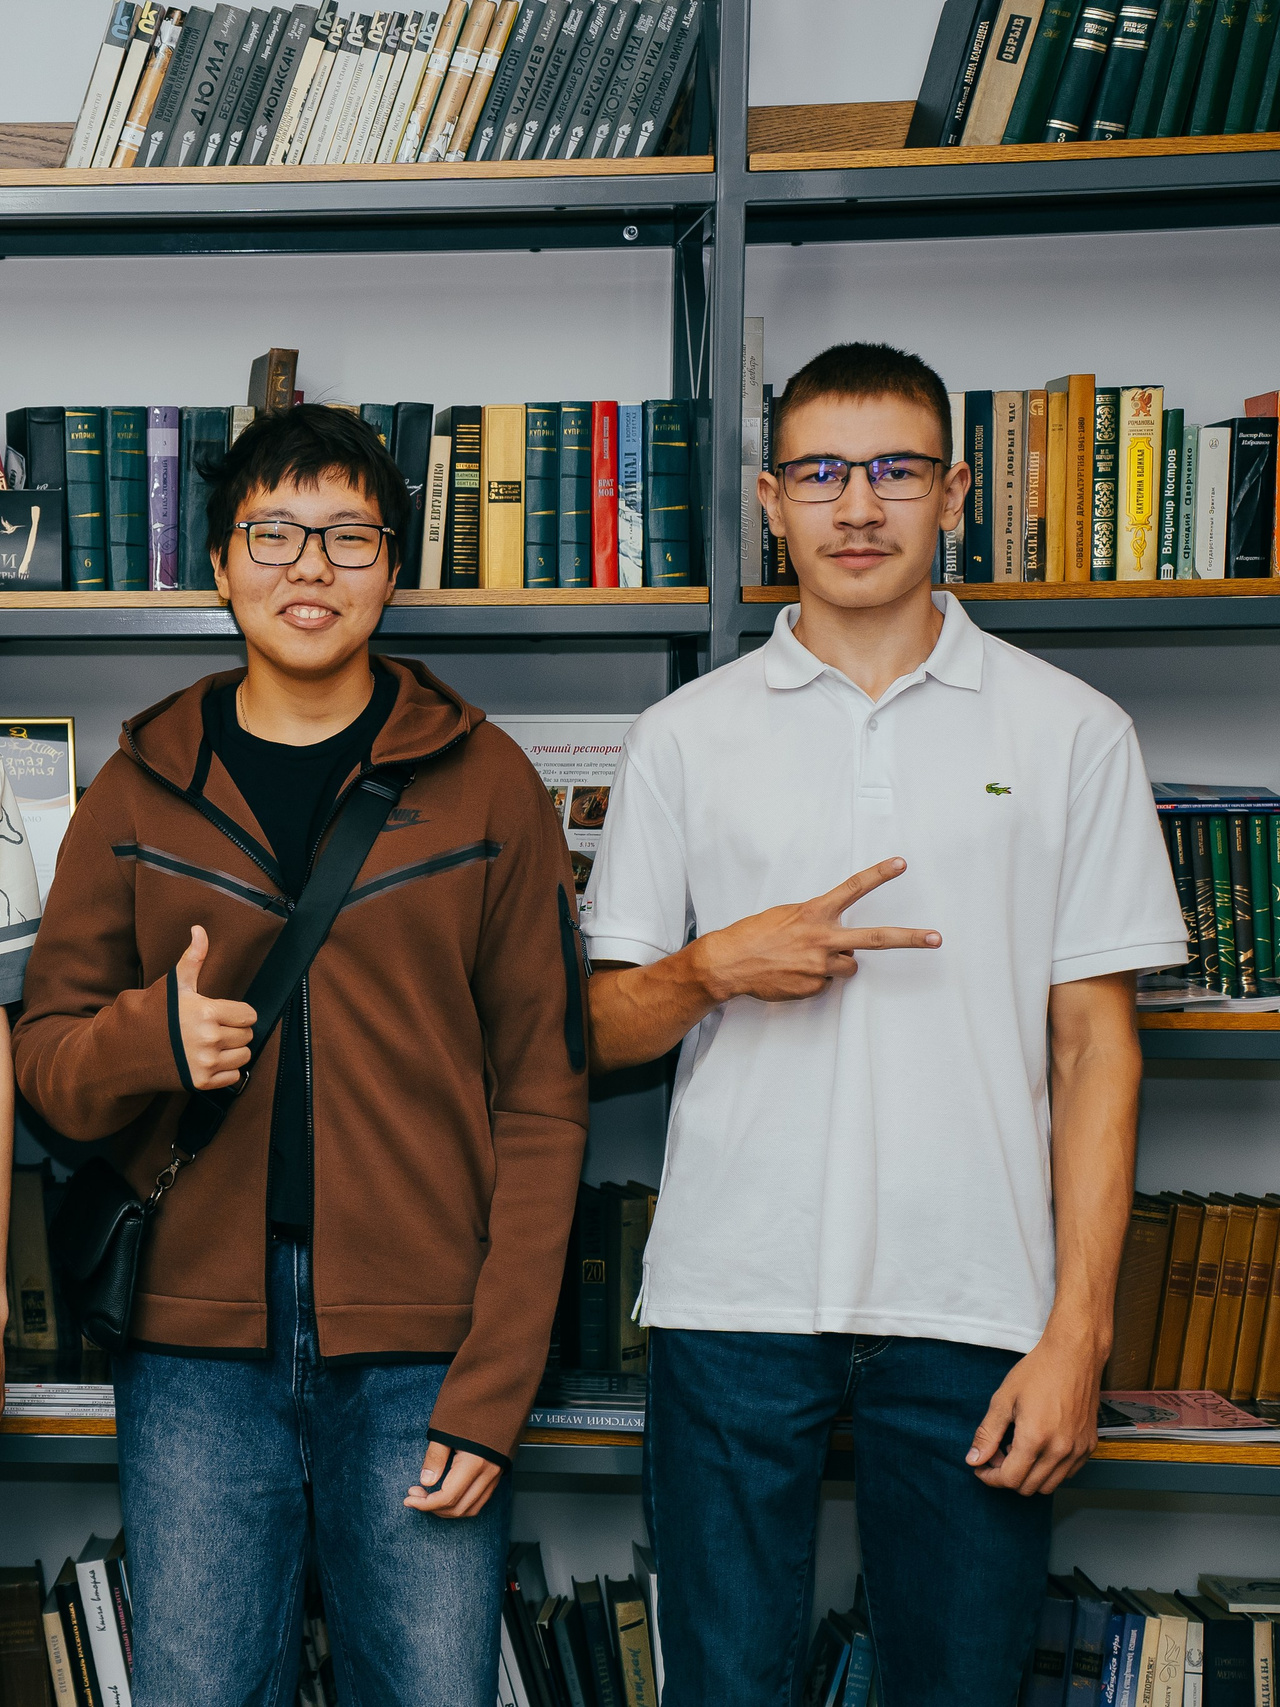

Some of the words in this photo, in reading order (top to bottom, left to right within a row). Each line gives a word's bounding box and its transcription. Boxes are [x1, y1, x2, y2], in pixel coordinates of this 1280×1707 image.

[969, 20, 990, 62] КАРЕНИНА
[1001, 17, 1025, 60] ОБРЫВ
[162, 89, 180, 122] ВЕЛИКОЙ
[173, 28, 200, 89] ОТЕЧЕСТВЕННОЙ
[190, 39, 228, 126] ДЮМА
[262, 45, 296, 123] МОПАССАН
[324, 80, 342, 122] ПОШЕХОНСКАЯ
[337, 54, 350, 80] СТАРИНА
[486, 48, 521, 123] ВАШИНГТОН
[510, 44, 545, 115] ЧААДАЕВ
[534, 47, 567, 111] ПУАНКАРЕ
[555, 75, 577, 122] АЛЕКСАНДР
[572, 38, 596, 76] БЛОК
[580, 47, 614, 117] БРУСИЛОВ
[601, 75, 629, 123] ЖОРЖ
[620, 34, 644, 71] САНД
[627, 71, 651, 117] ДЖОН
[645, 40, 664, 67] РИД
[648, 70, 673, 119] ЛЕОНАРДО
[670, 27, 690, 61] ВИНЧИ
[963, 62, 978, 84] АННА
[218, 66, 244, 120] БЕХТЕРЕВ
[236, 63, 266, 125] ПАГАНИНИ
[334, 96, 353, 141] ОЧАРОВАННЫЙ
[349, 62, 365, 96] СТРАННИК
[86, 92, 102, 131] ДРЕВНОСТЕЙ
[108, 100, 122, 130] ТРАГЕДИИ
[391, 101, 406, 132] РАССКАЗЫ
[296, 116, 309, 145] ДЕРЕВНЯ
[356, 116, 370, 146] НАКАНУНЕ
[1057, 132, 1066, 143] 3
[1008, 402, 1016, 423] ЧАС
[529, 429, 555, 437] КУПРИН
[975, 425, 984, 450] ПОЭЗИИ
[1077, 416, 1085, 452] 1941-1980
[974, 451, 983, 487] ИРКУТСКОЙ
[1007, 429, 1016, 476] ДОБРЫЙ
[1136, 448, 1145, 478] ВЕЛИКАЯ
[598, 479, 614, 487] БРАТ
[624, 451, 637, 507] БАЙКАЛ
[1028, 450, 1040, 508] ШУКШИН
[1076, 454, 1085, 516] ДРАМАТУРГИЯ
[1164, 448, 1177, 497] Костров
[430, 463, 444, 520] ЕВТУШЕНКО
[598, 487, 614, 497] МОЙ
[974, 488, 984, 524] АНТОЛОГИЯ
[1136, 479, 1144, 514] ЕКАТЕРИНА
[1208, 486, 1216, 515] Эрмитаж
[428, 522, 440, 542] ЕВГ.
[1005, 505, 1014, 534] Розов
[1162, 500, 1174, 555] Владимир
[666, 553, 672, 562] 4
[1005, 538, 1014, 575] Виктор
[1027, 513, 1038, 569] ВАСИЛИЙ
[1076, 519, 1084, 568] СОВЕТСКАЯ
[1206, 517, 1215, 572] Государственный
[84, 558, 92, 568] 6
[538, 557, 545, 567] 3
[574, 557, 581, 567] 2
[529, 743, 571, 755] лучший
[9, 766, 55, 780] армия
[585, 1263, 601, 1281] 20
[547, 1414, 583, 1424] МУЗЕЙ
[89, 1569, 102, 1602] вторая
[68, 1602, 77, 1625] ЯЗЫКА
[96, 1606, 106, 1632] Книга
[113, 1586, 127, 1633] УНИВЕРСИТЕТ
[50, 1634, 62, 1664] ЩИПАЧЕВ
[73, 1625, 84, 1658] РУССКОГО
[57, 1668, 67, 1694] СТЕПАН
[79, 1658, 90, 1687] СЛОВАРЬ
